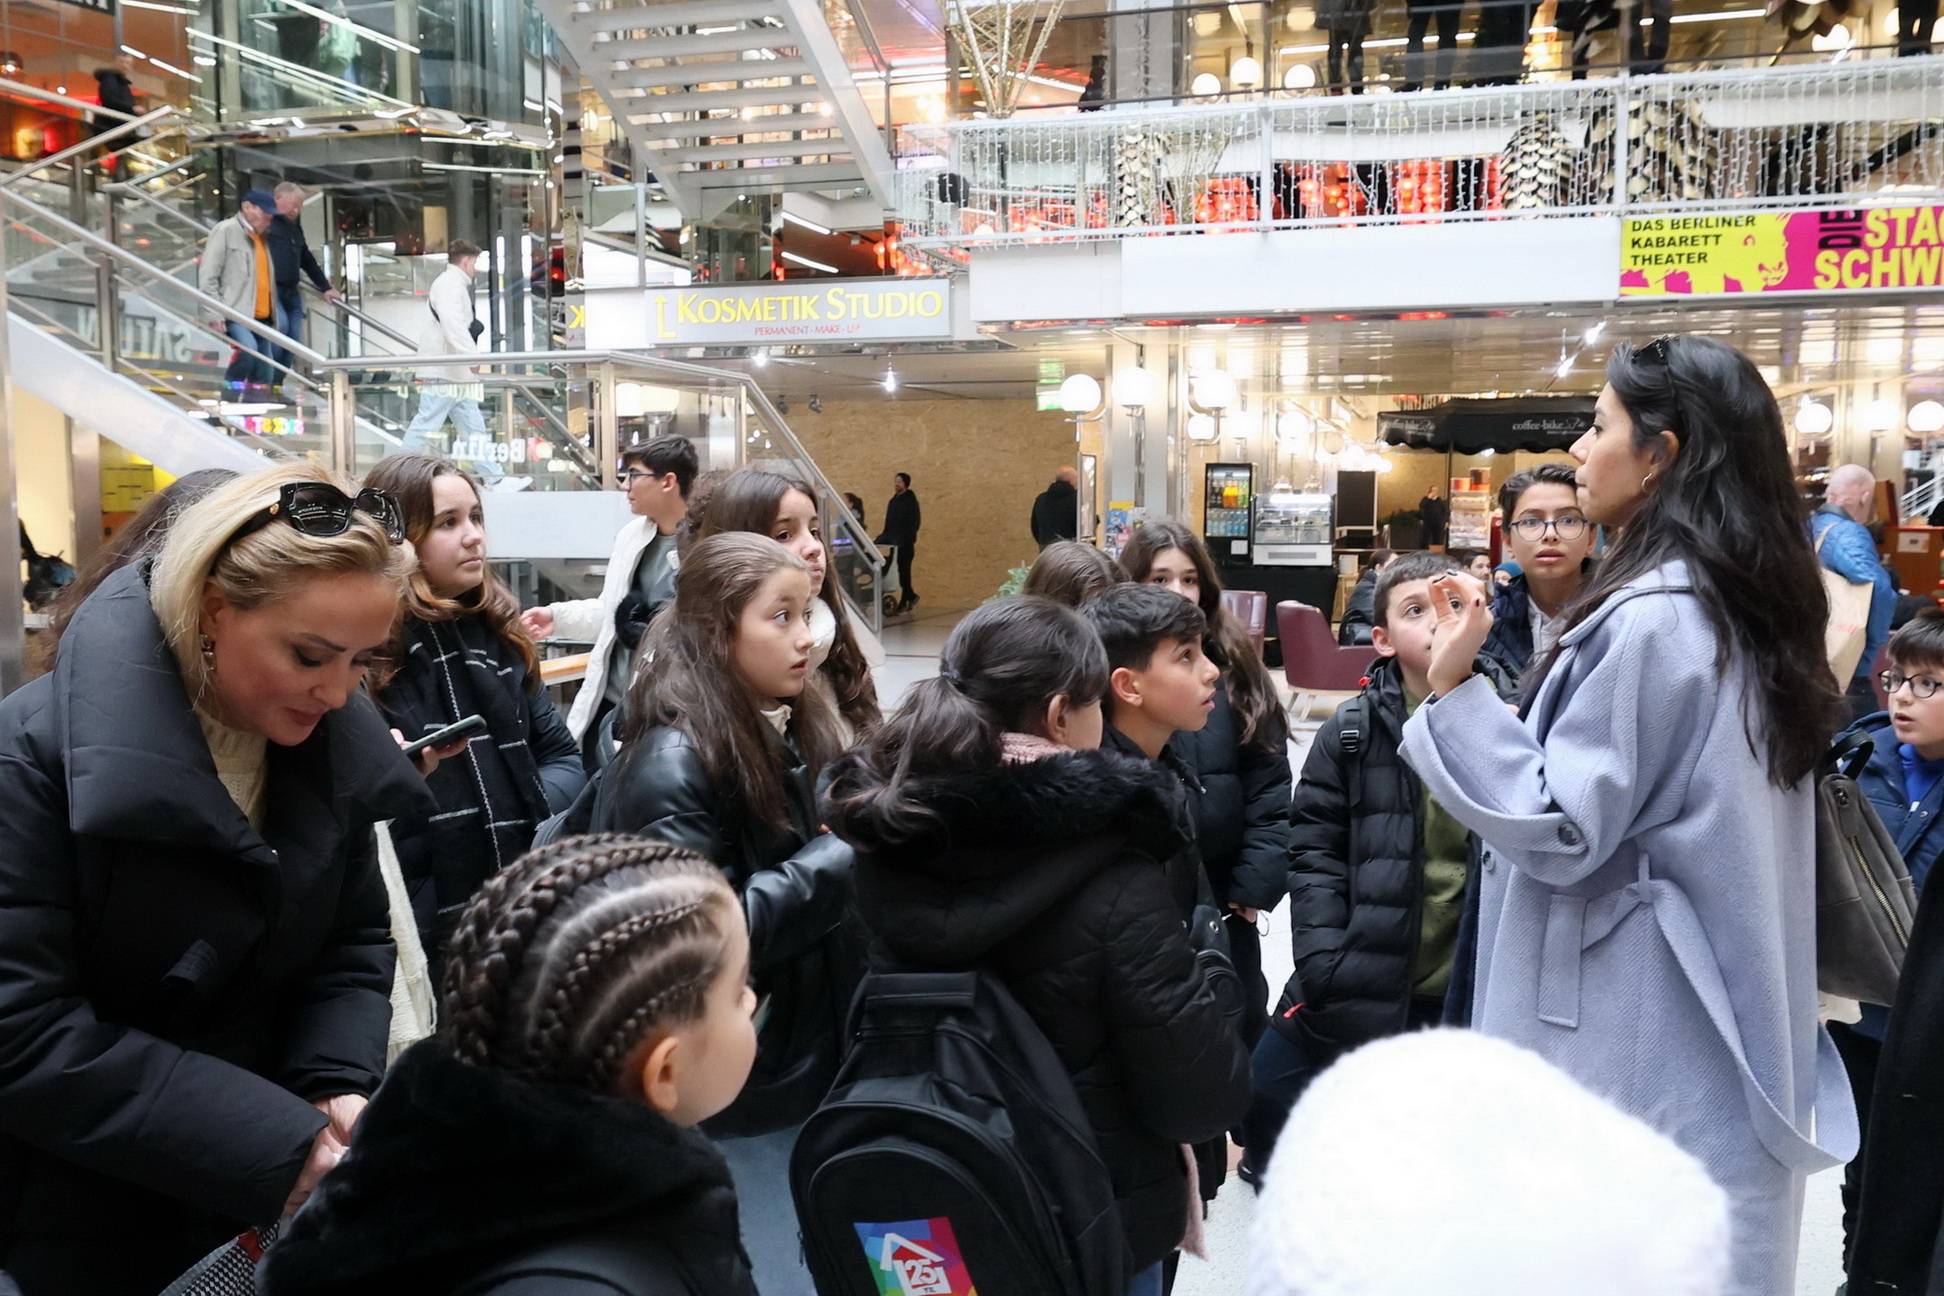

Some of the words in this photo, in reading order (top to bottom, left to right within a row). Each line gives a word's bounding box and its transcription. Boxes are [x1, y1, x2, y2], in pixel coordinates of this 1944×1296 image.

[1631, 219, 1665, 232] DAS
[1670, 215, 1757, 231] BERLINER
[1864, 207, 1944, 249] STA
[1631, 234, 1723, 249] KABARETT
[1630, 252, 1708, 266] THEATER
[1814, 247, 1944, 290] SCHW
[754, 326, 810, 335] PERMANENT
[815, 324, 841, 334] MAKE
[847, 324, 861, 333] UP
